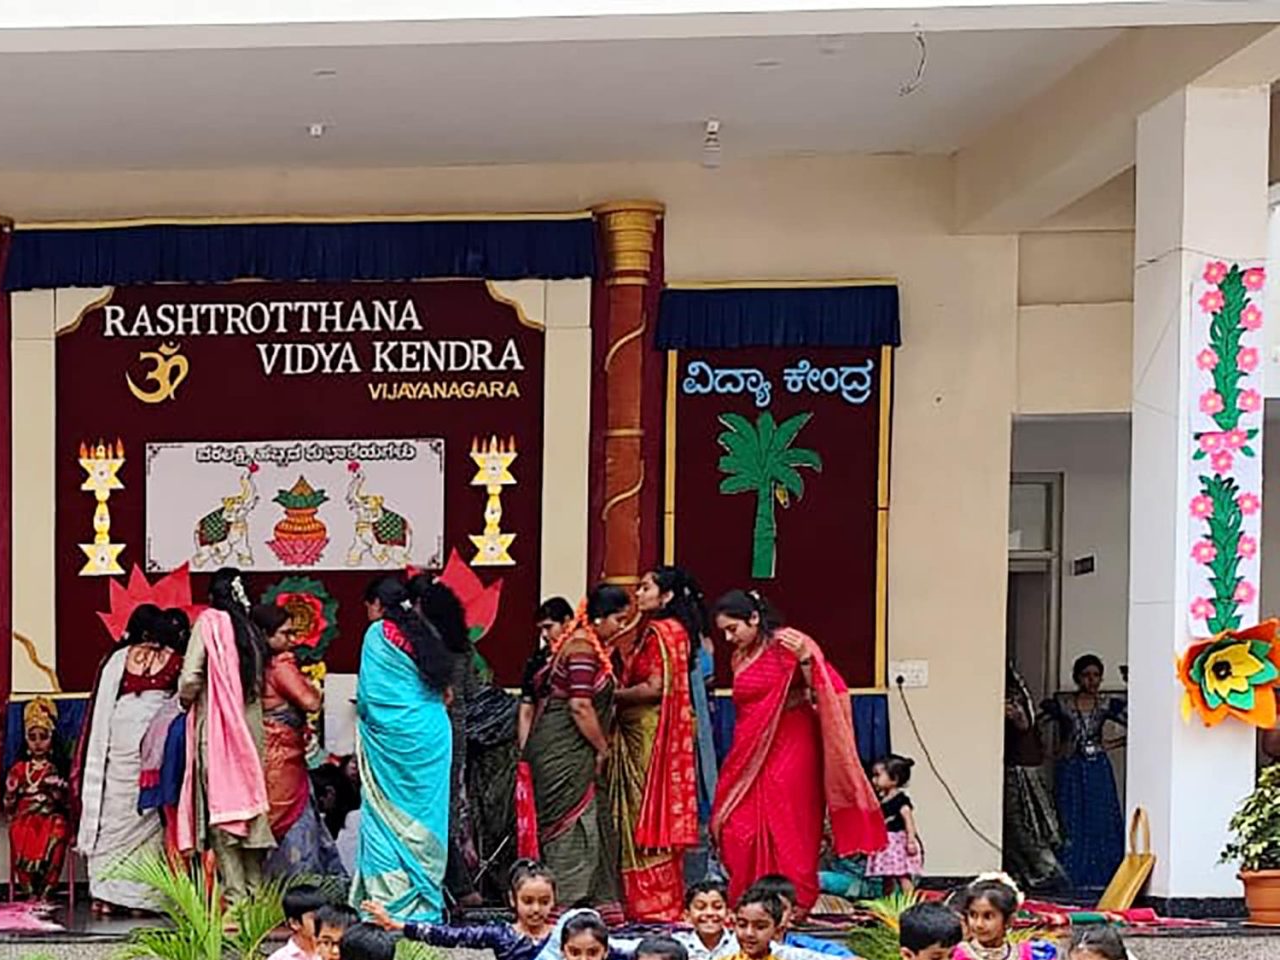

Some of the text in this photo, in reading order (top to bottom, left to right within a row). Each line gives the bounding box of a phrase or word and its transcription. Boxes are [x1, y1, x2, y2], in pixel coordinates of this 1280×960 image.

[104, 300, 423, 337] RASHTROTTHANA
[256, 339, 525, 376] VIDYA KENDRA
[368, 381, 521, 401] VIJAYANAGARA
[682, 360, 874, 407] ವಿದ್ಯಾ ಕೇಂದ್ರ
